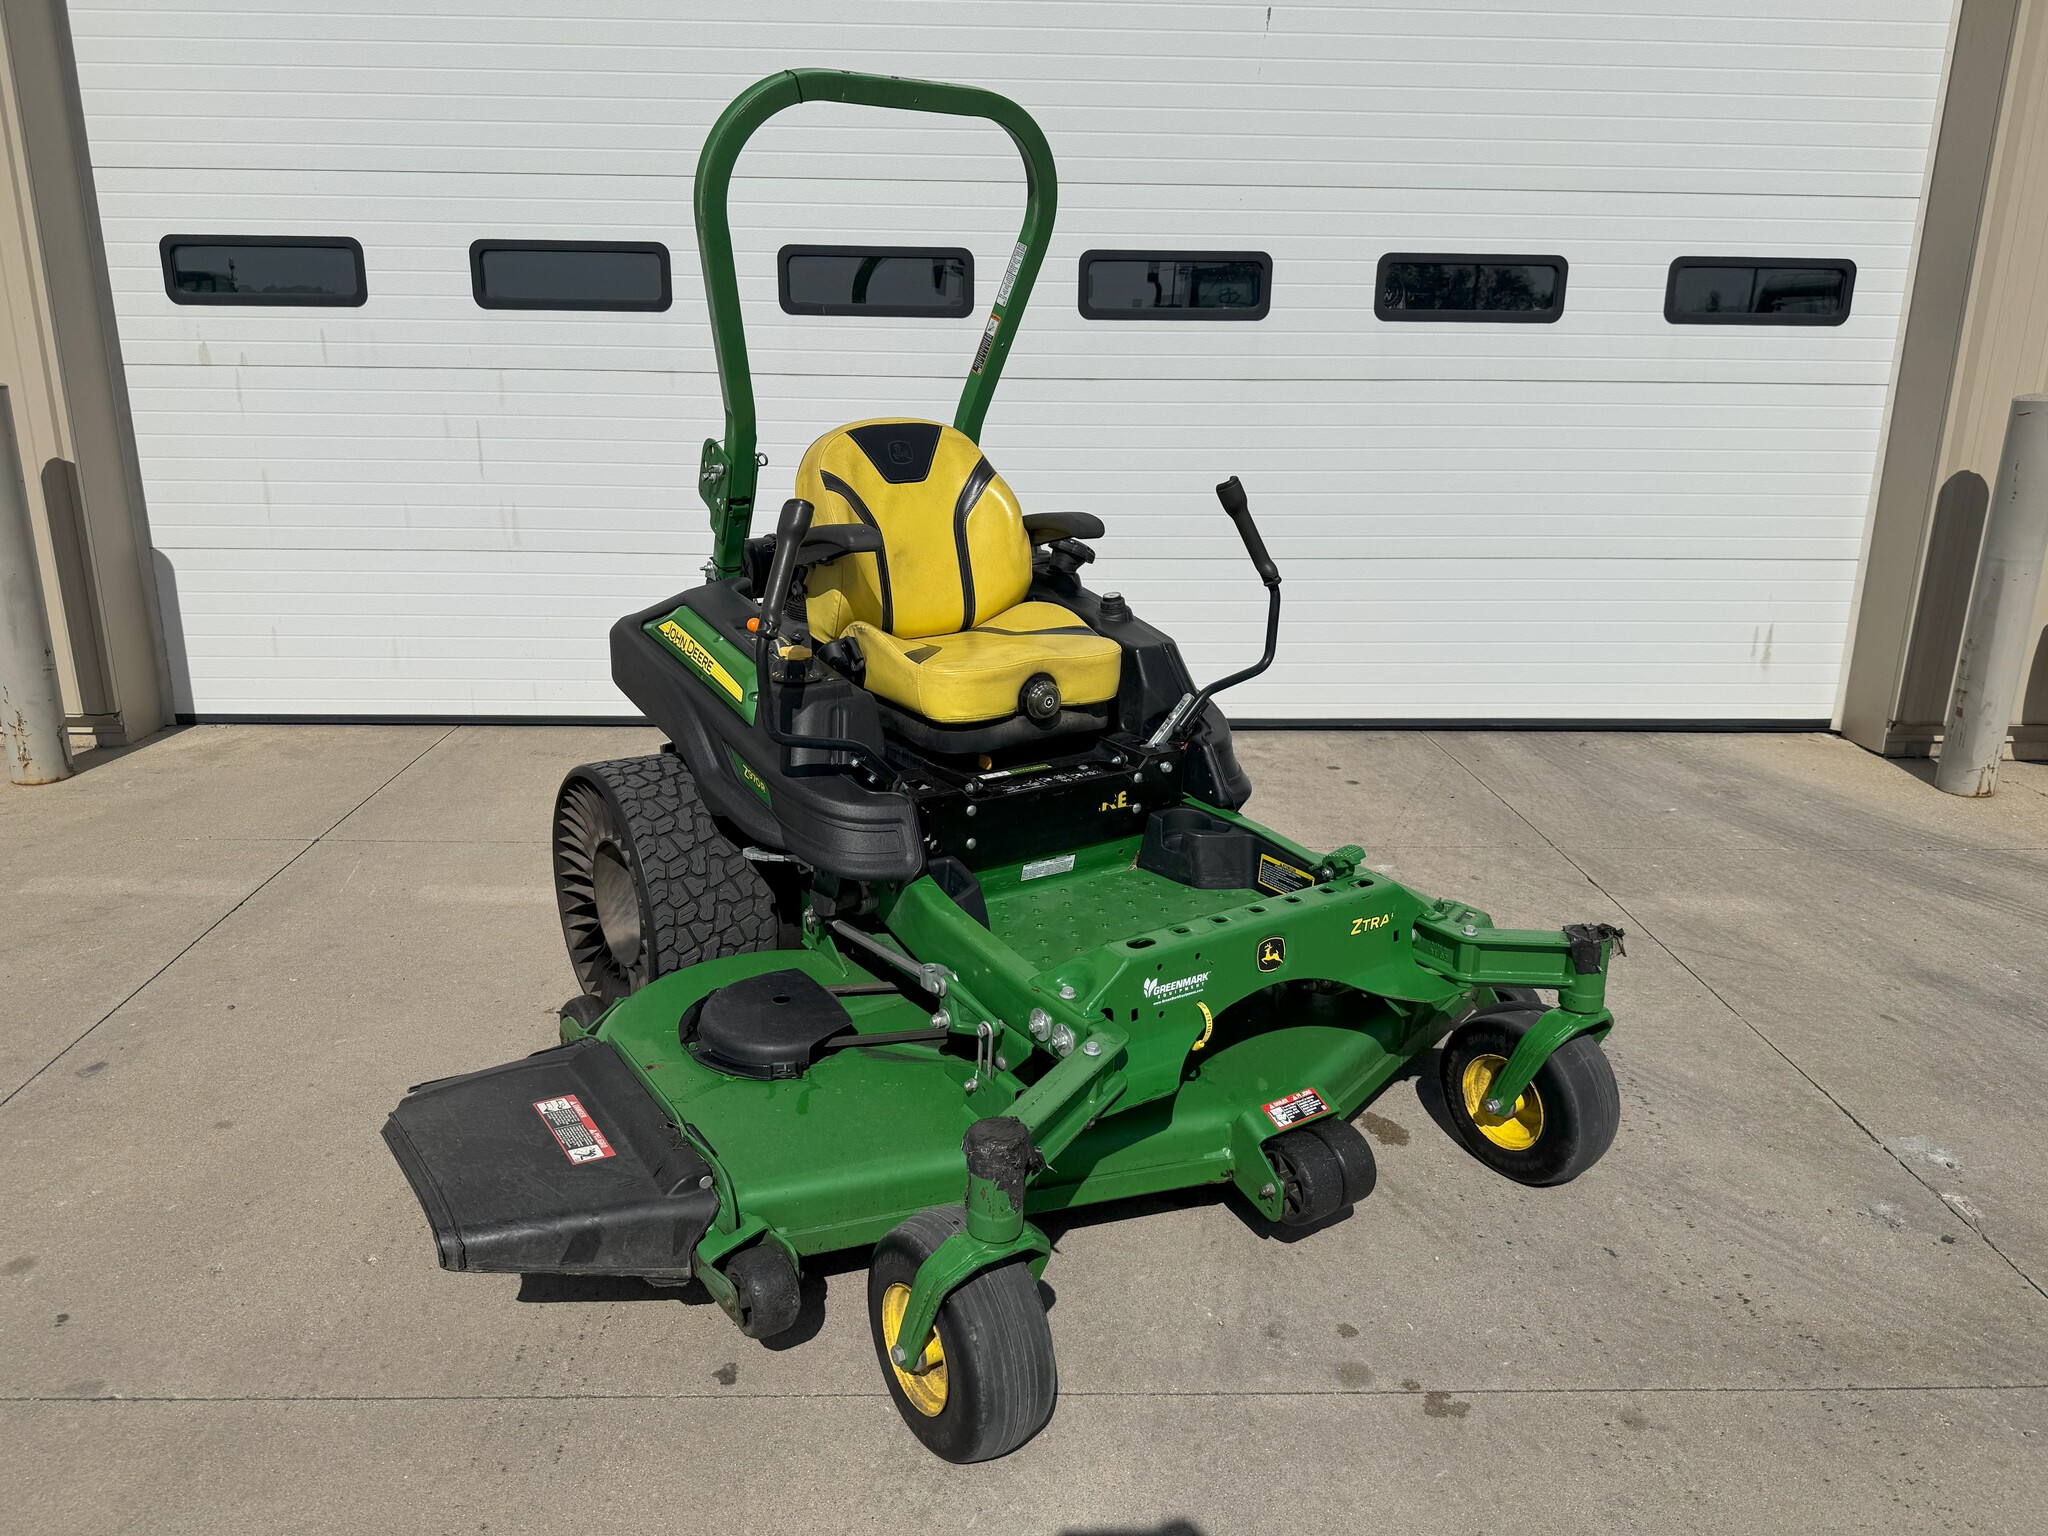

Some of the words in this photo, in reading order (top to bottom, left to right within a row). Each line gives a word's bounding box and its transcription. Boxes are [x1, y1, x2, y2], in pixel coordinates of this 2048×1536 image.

[665, 623, 687, 650] JOHN
[686, 640, 714, 673] DEERE
[742, 764, 766, 793] Z970R
[1350, 912, 1394, 936] ZTRA
[1153, 972, 1208, 996] GREENMARK
[1157, 982, 1205, 999] EQUIPMENT
